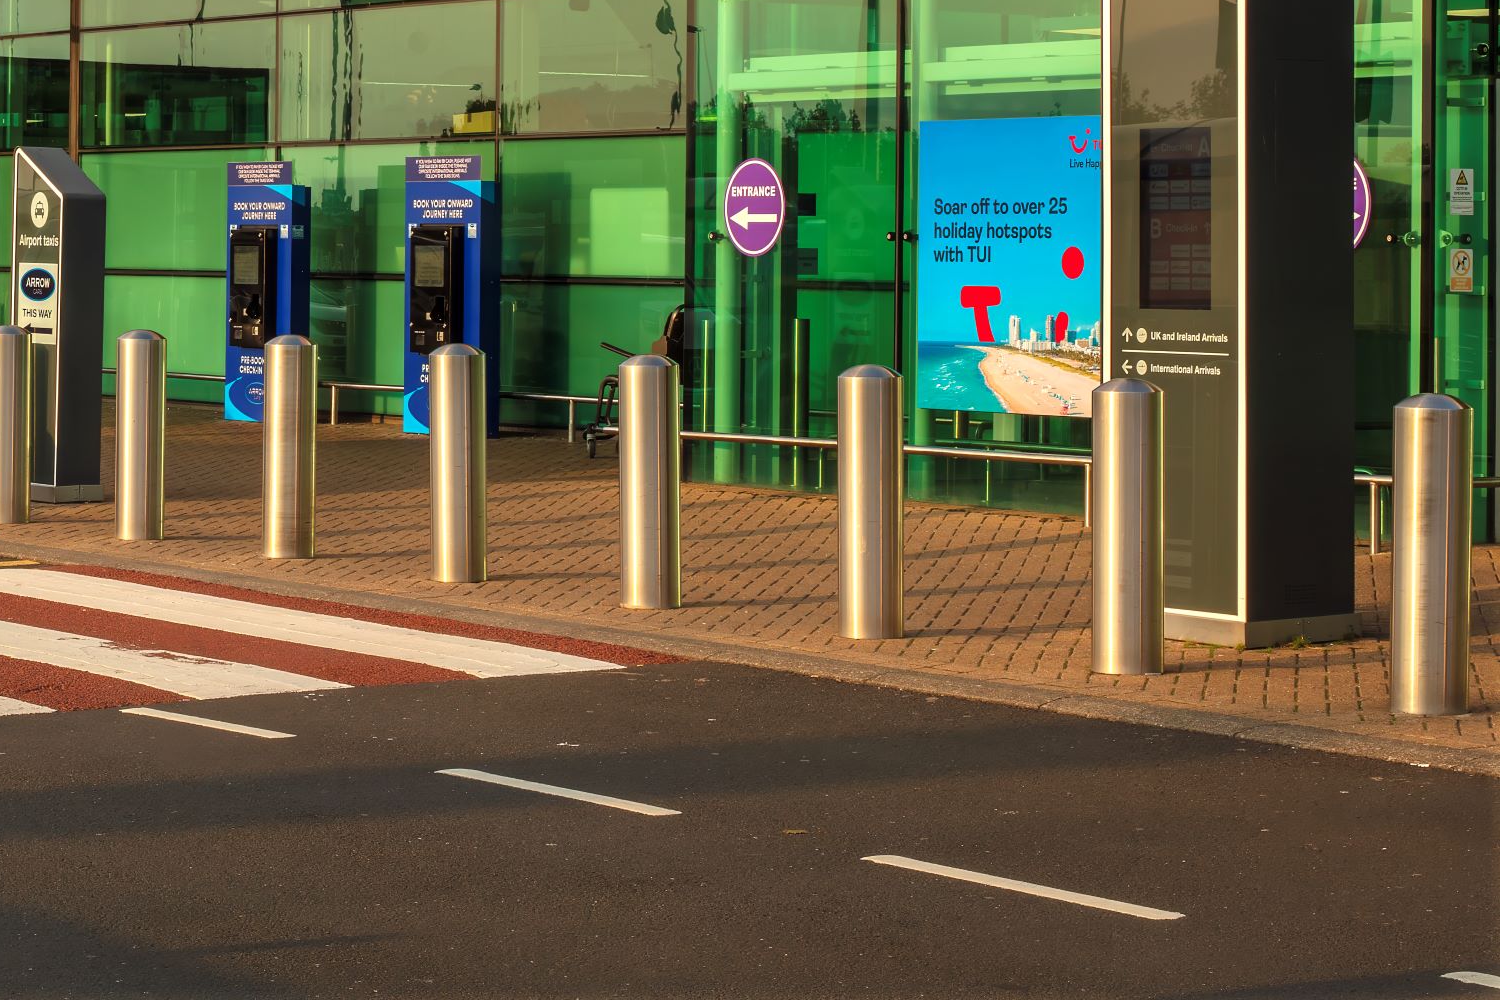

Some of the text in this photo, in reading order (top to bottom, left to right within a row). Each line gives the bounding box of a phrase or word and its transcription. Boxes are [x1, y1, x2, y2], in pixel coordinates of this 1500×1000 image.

[1070, 159, 1084, 168] Live
[731, 185, 776, 197] ENTRANCE
[234, 202, 285, 210] BOOK YOUR ONWARD
[413, 199, 473, 208] BOOK YOUR ONWARD
[934, 197, 1067, 215] Soar off to over 25
[242, 212, 277, 220] JOURNEY HERE
[422, 210, 463, 218] JOURNEY HERE
[934, 222, 1052, 243] holiday hotspots
[20, 234, 59, 248] Airport taxis
[934, 246, 991, 262] with TUI
[26, 278, 51, 288] ARROW
[23, 308, 53, 319] THIS WAY
[1150, 332, 1228, 343] UK and Ireland Arrivals
[240, 365, 263, 374] CHECK-IN
[1150, 364, 1221, 375] International Arrivals
